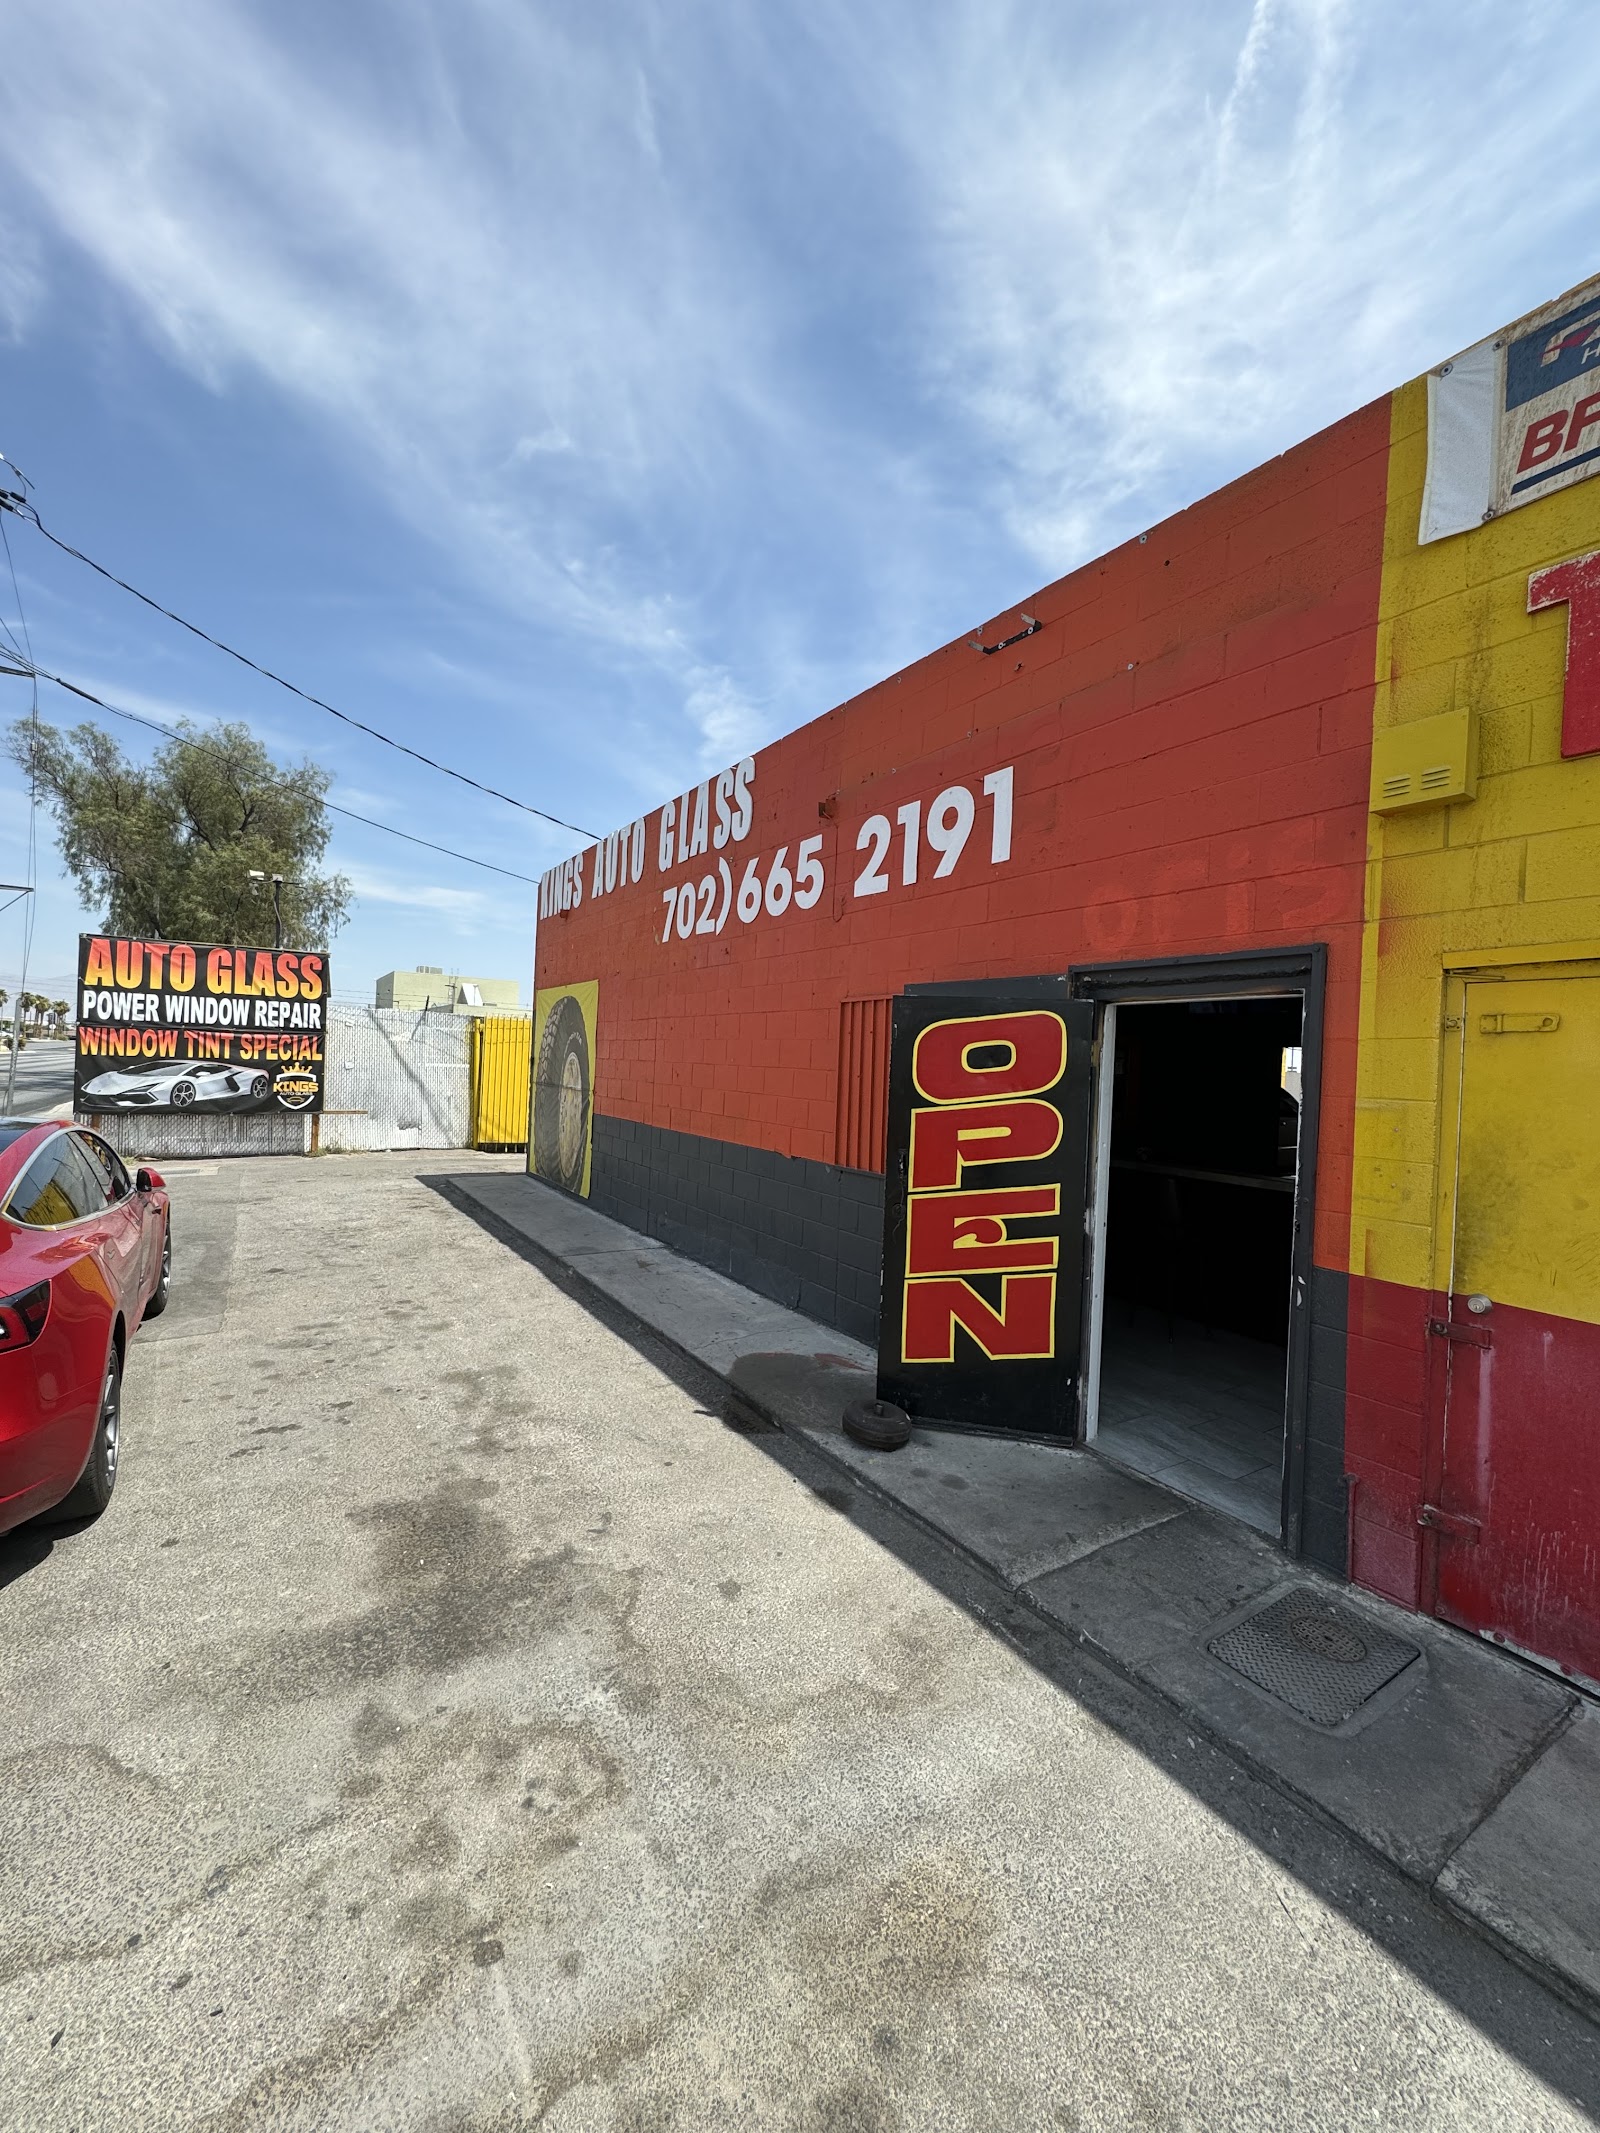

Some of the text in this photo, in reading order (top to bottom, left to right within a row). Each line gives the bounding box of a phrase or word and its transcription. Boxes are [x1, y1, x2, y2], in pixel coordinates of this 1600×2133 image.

[539, 756, 756, 921] KINGS AUTO GLASS
[662, 833, 824, 943] 702)665
[853, 765, 1014, 898] 2191
[84, 938, 323, 1000] AUTO GLASS
[82, 989, 322, 1030] POWER WINDOW REPAIR
[79, 1026, 323, 1061] WINDOW TINT SPECIAL
[272, 1080, 319, 1093] KINGS
[900, 1009, 1068, 1364] OPEN
